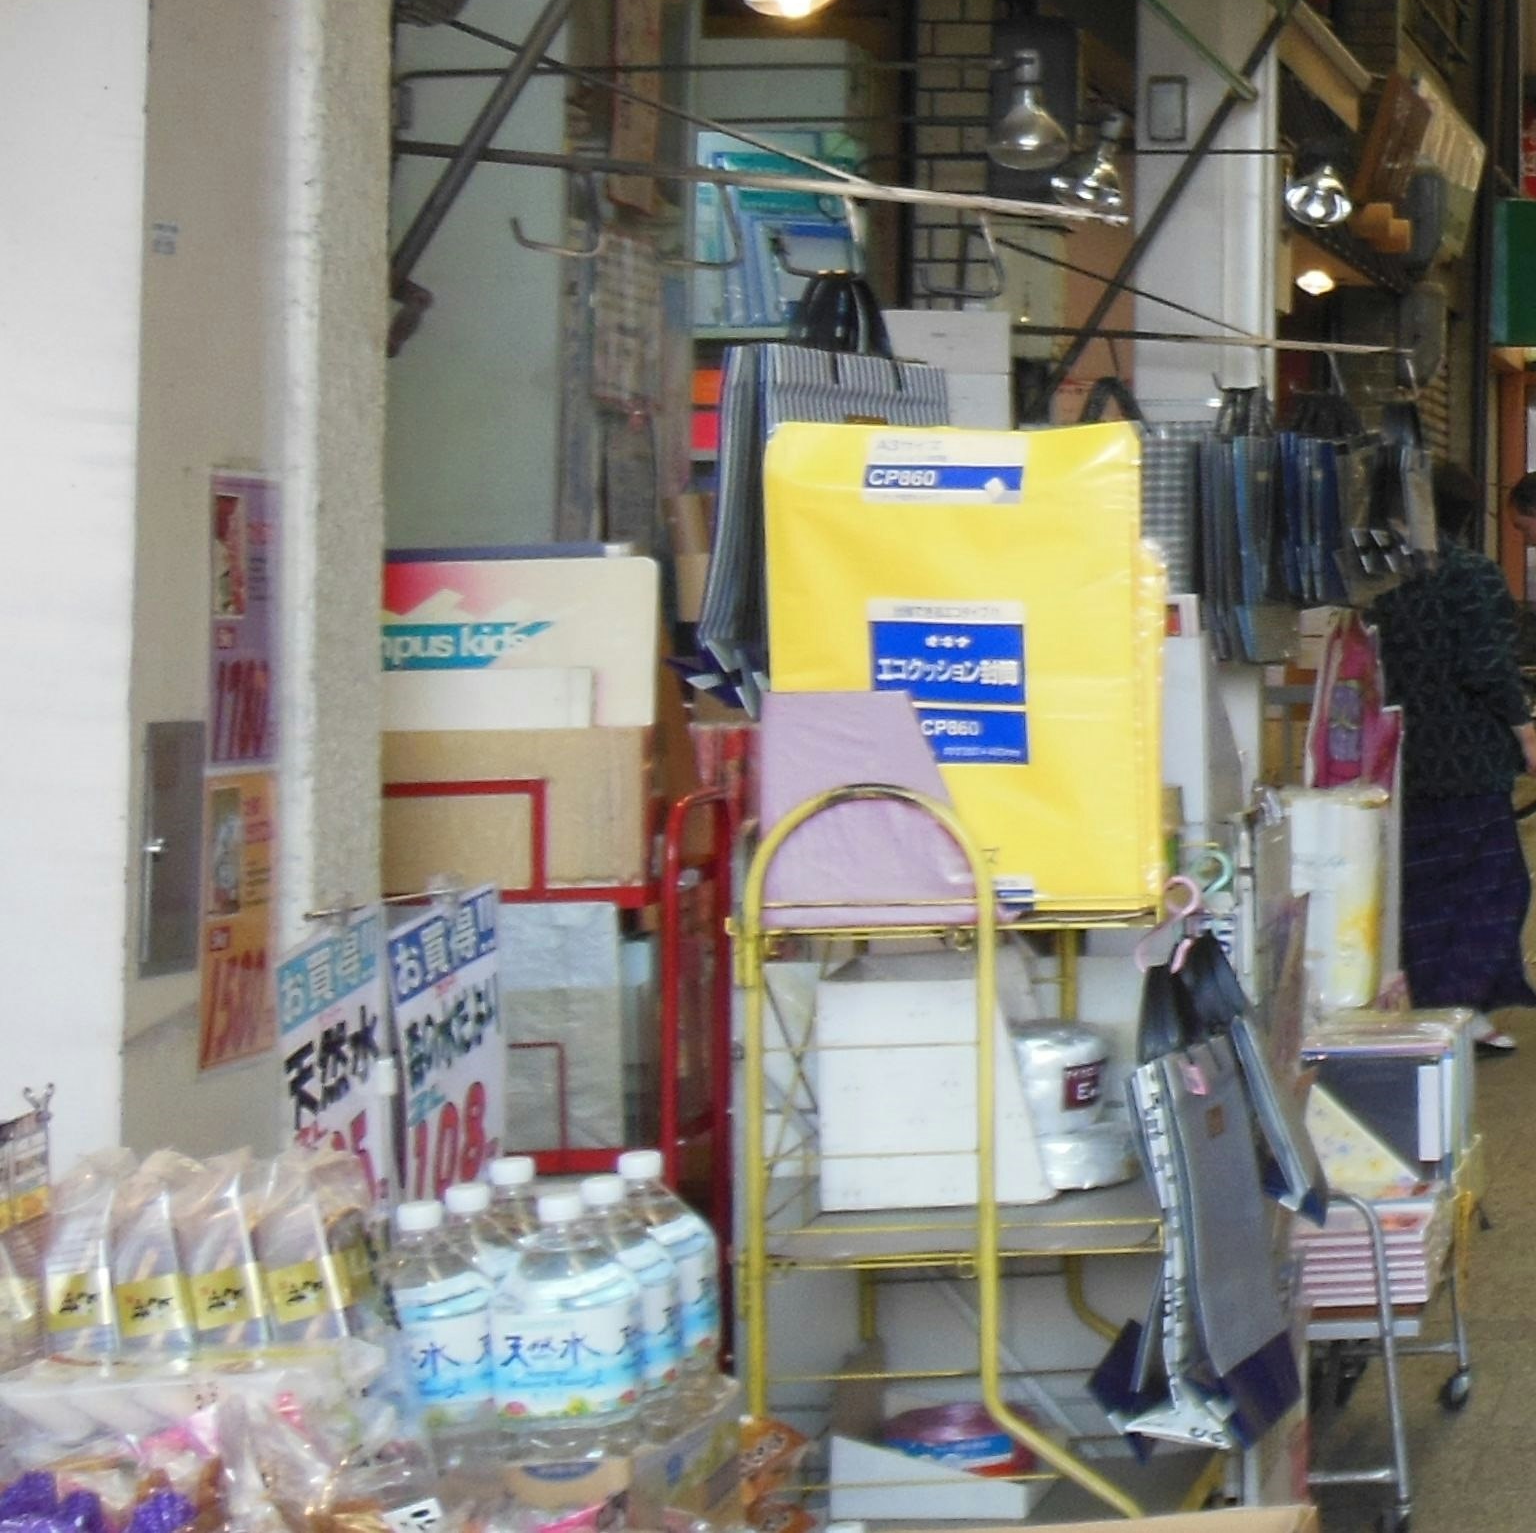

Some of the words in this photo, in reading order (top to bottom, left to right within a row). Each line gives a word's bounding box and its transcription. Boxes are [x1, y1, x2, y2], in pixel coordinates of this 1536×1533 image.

[284, 1004, 380, 1130] 天然水
[500, 1331, 606, 1369] 天然水
